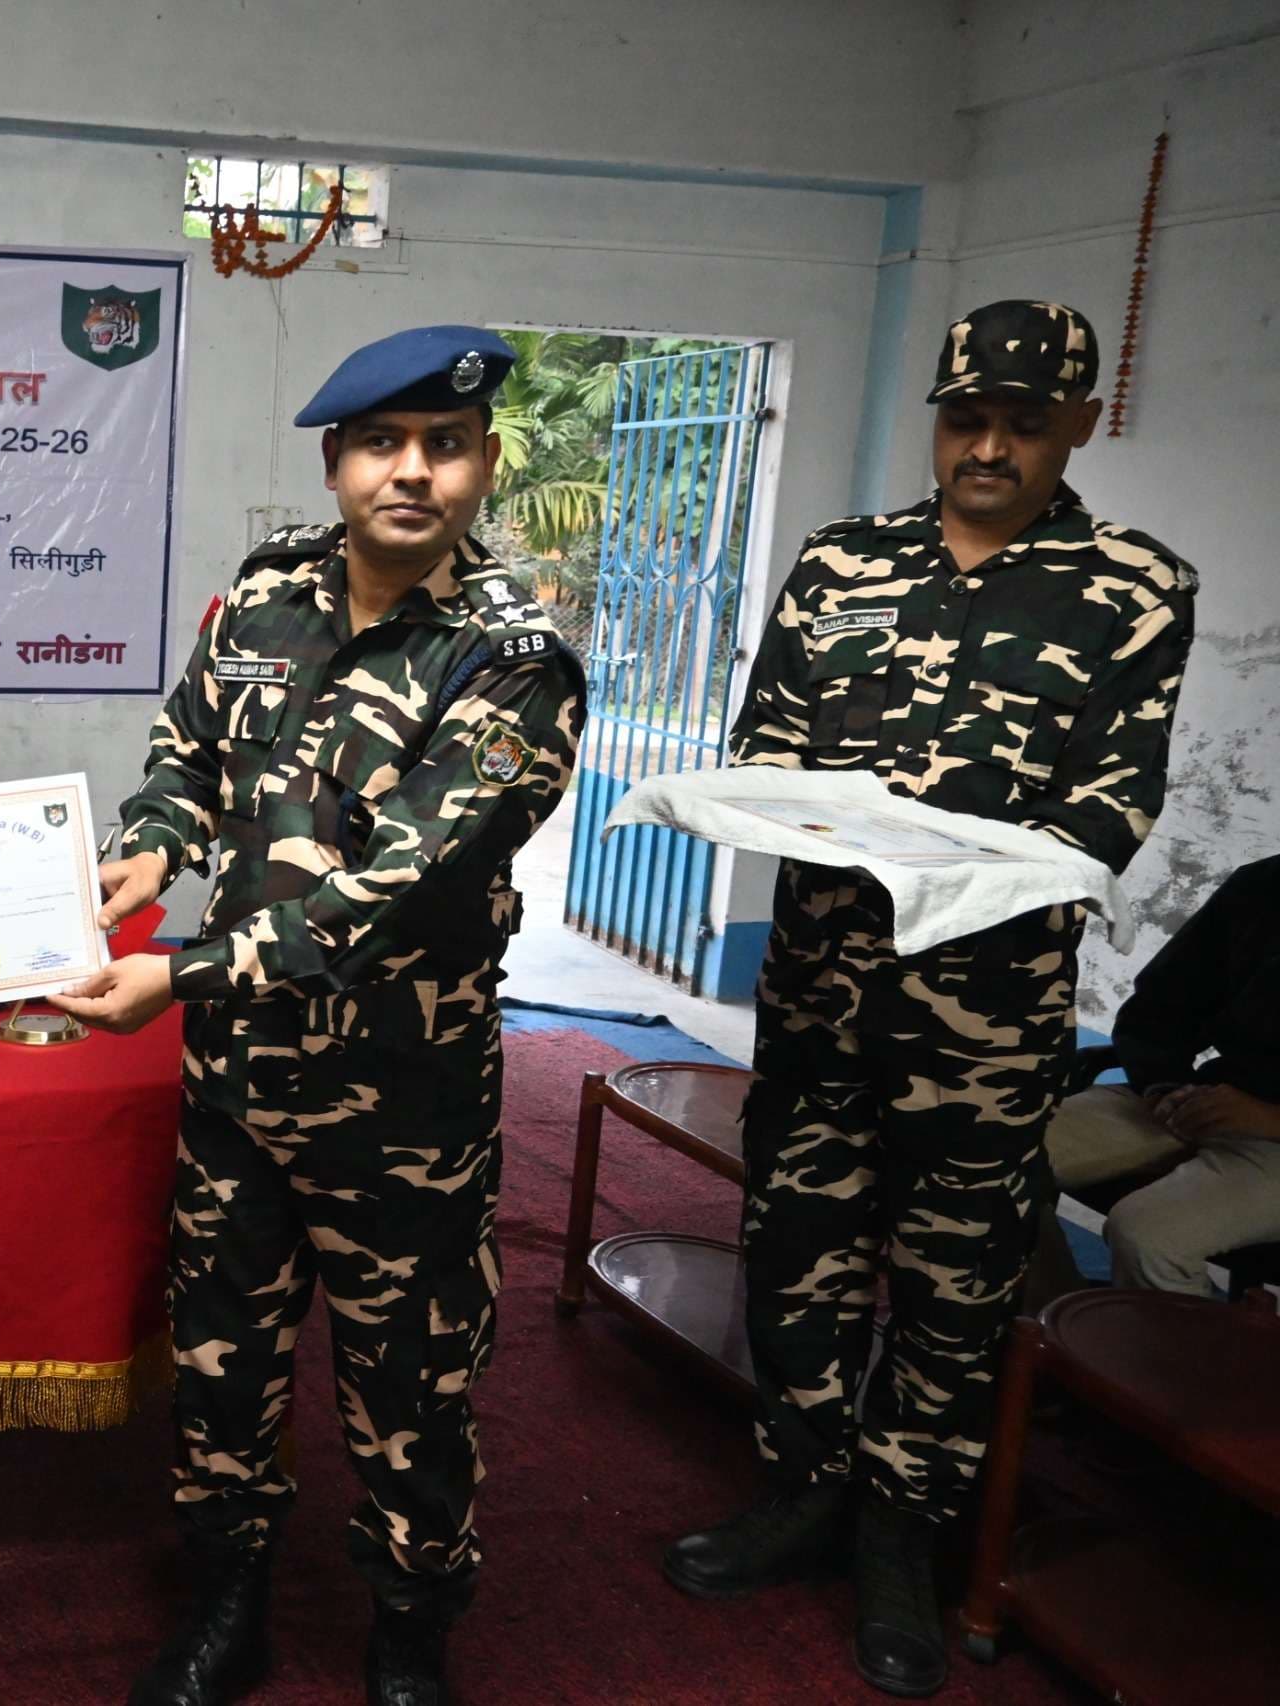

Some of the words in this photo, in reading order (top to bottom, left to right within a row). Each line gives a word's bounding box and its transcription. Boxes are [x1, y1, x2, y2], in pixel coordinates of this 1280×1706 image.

[9, 548, 106, 577] सिलीगुड़ी
[854, 615, 893, 624] VISHNU
[16, 633, 127, 665] रानीडंगा
[503, 633, 545, 657] SSB
